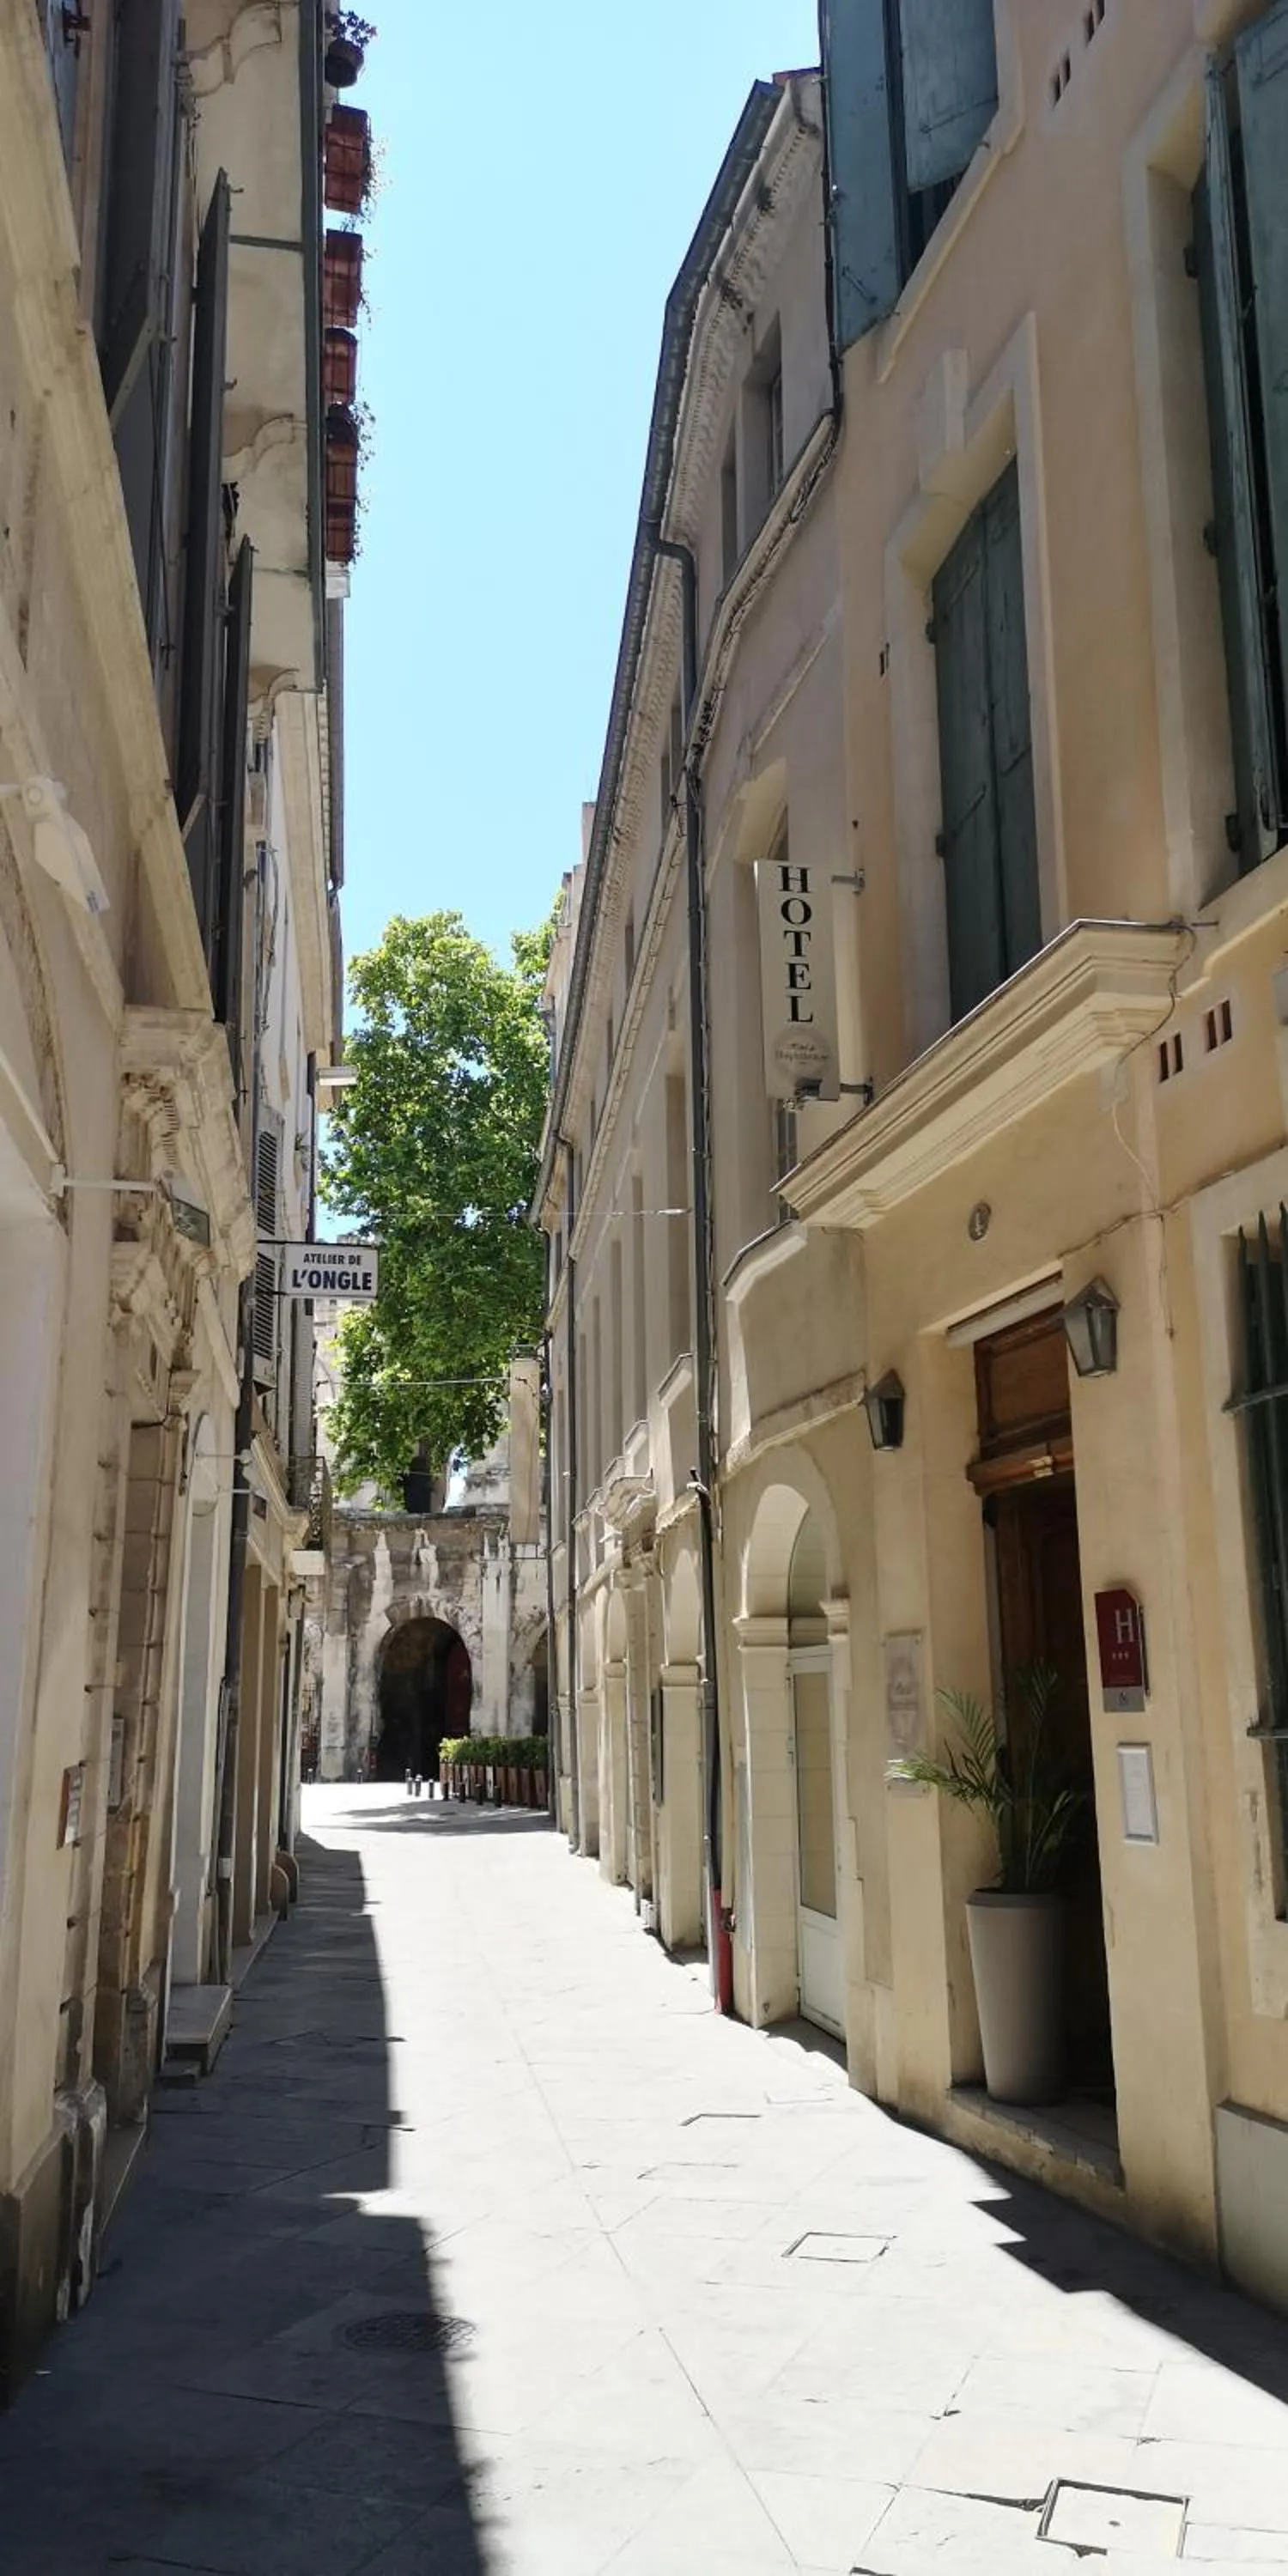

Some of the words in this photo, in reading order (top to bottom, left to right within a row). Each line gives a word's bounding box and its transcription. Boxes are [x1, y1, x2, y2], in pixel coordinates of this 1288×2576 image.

[778, 866, 813, 1023] HOTEL
[303, 1253, 345, 1265] ATELIER
[348, 1255, 362, 1265] DE
[292, 1269, 372, 1291] L'ONGLE
[1115, 1607, 1134, 1643] H
